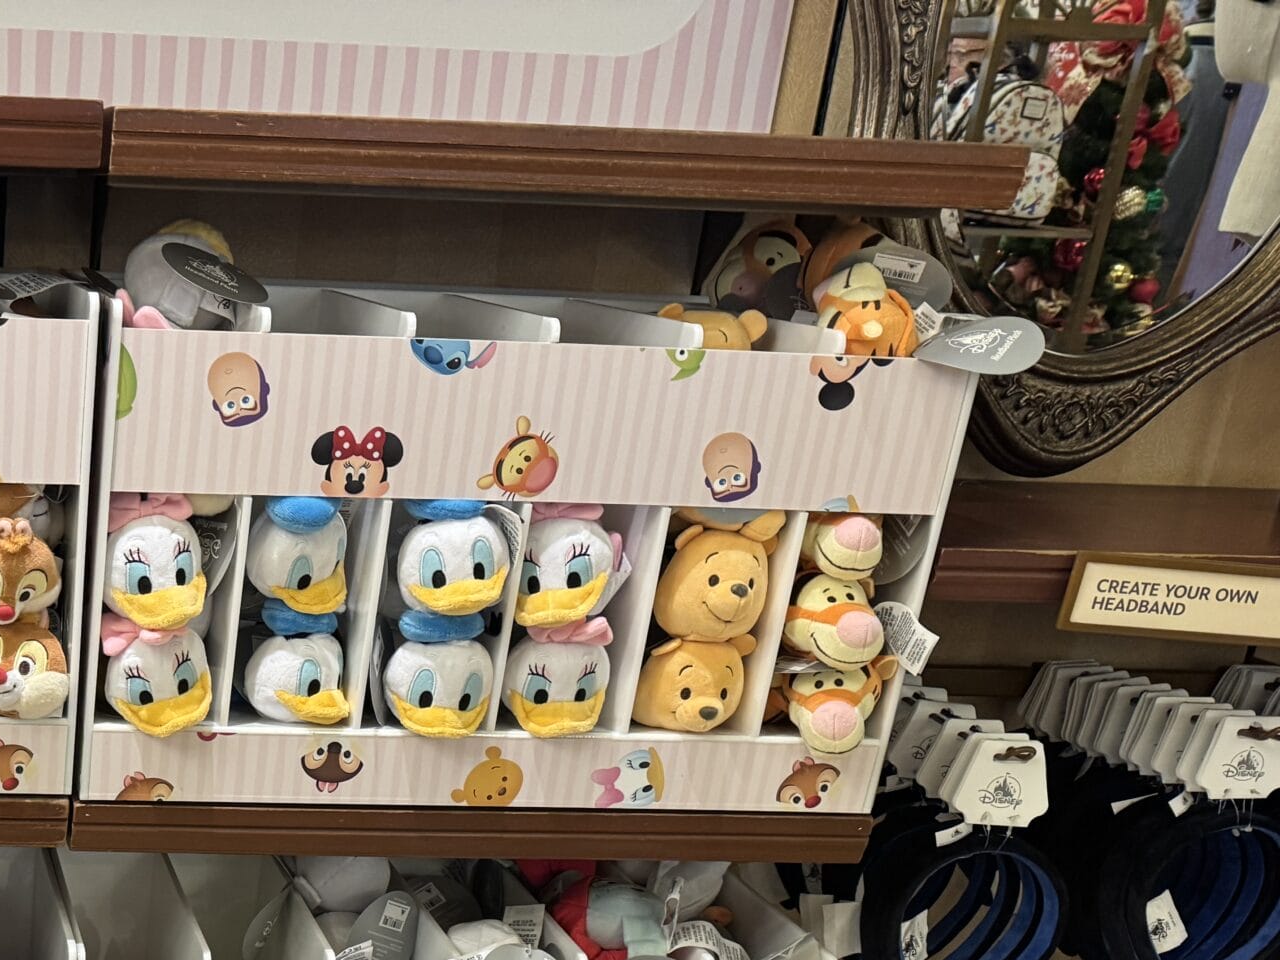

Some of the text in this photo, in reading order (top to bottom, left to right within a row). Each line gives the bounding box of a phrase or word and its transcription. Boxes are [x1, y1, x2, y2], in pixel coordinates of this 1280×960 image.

[1096, 578, 1259, 604] CREATE YOUR OWN
[1091, 596, 1186, 616] HEADBAND
[1222, 764, 1265, 782] Disney
[978, 790, 1023, 810] Disney
